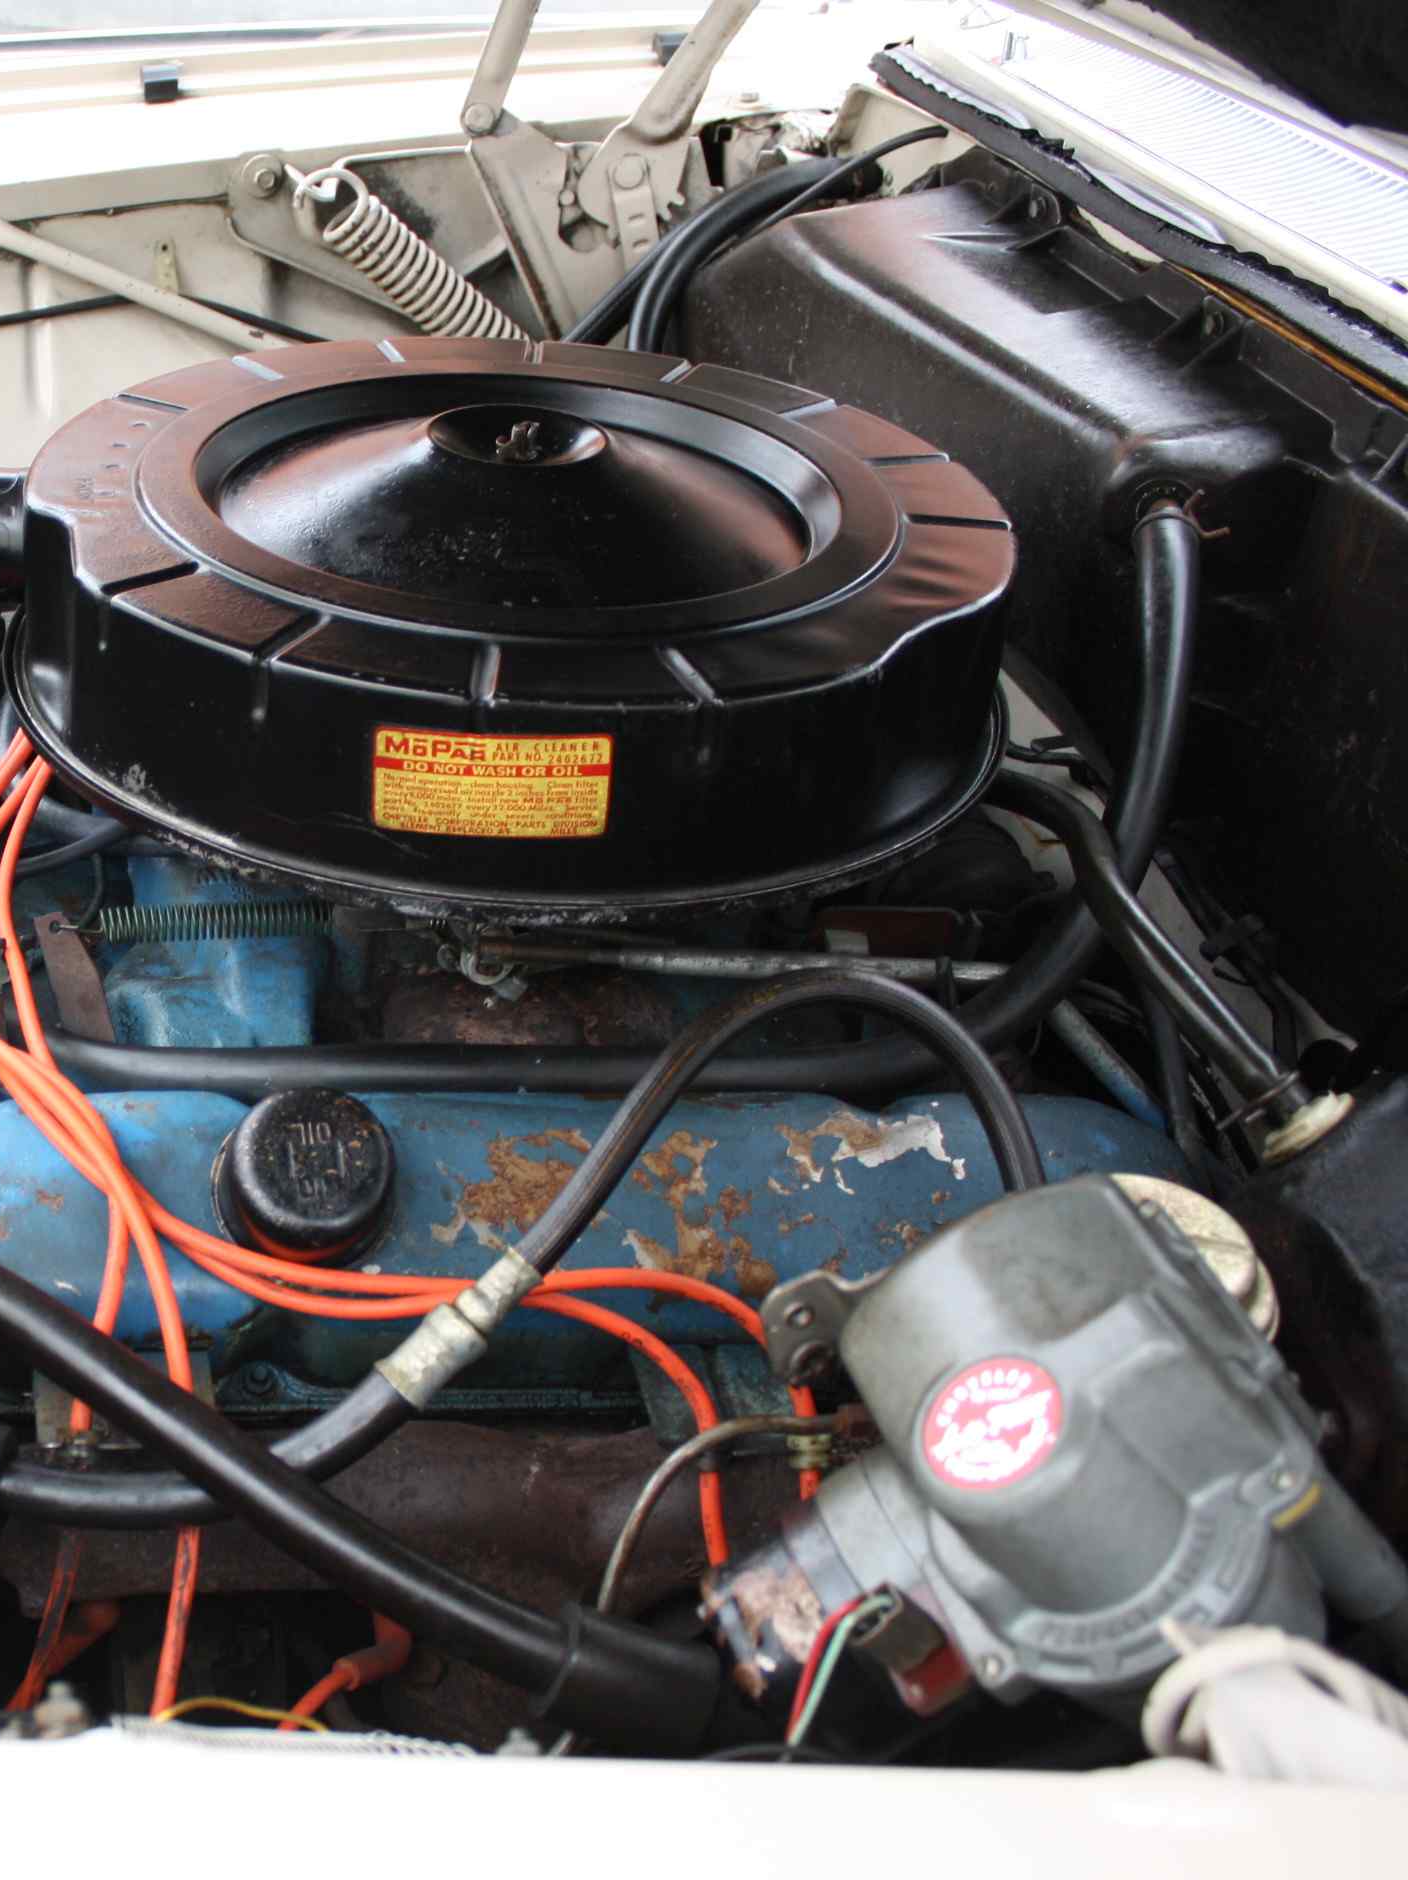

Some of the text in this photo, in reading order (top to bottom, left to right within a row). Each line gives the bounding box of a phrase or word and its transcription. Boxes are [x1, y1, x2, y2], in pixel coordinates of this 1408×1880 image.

[496, 741, 600, 752] AIR CLEANER
[491, 752, 521, 762] PART
[402, 760, 584, 777] DO NOT WASH OR OIL
[286, 1122, 332, 1145] OIL
